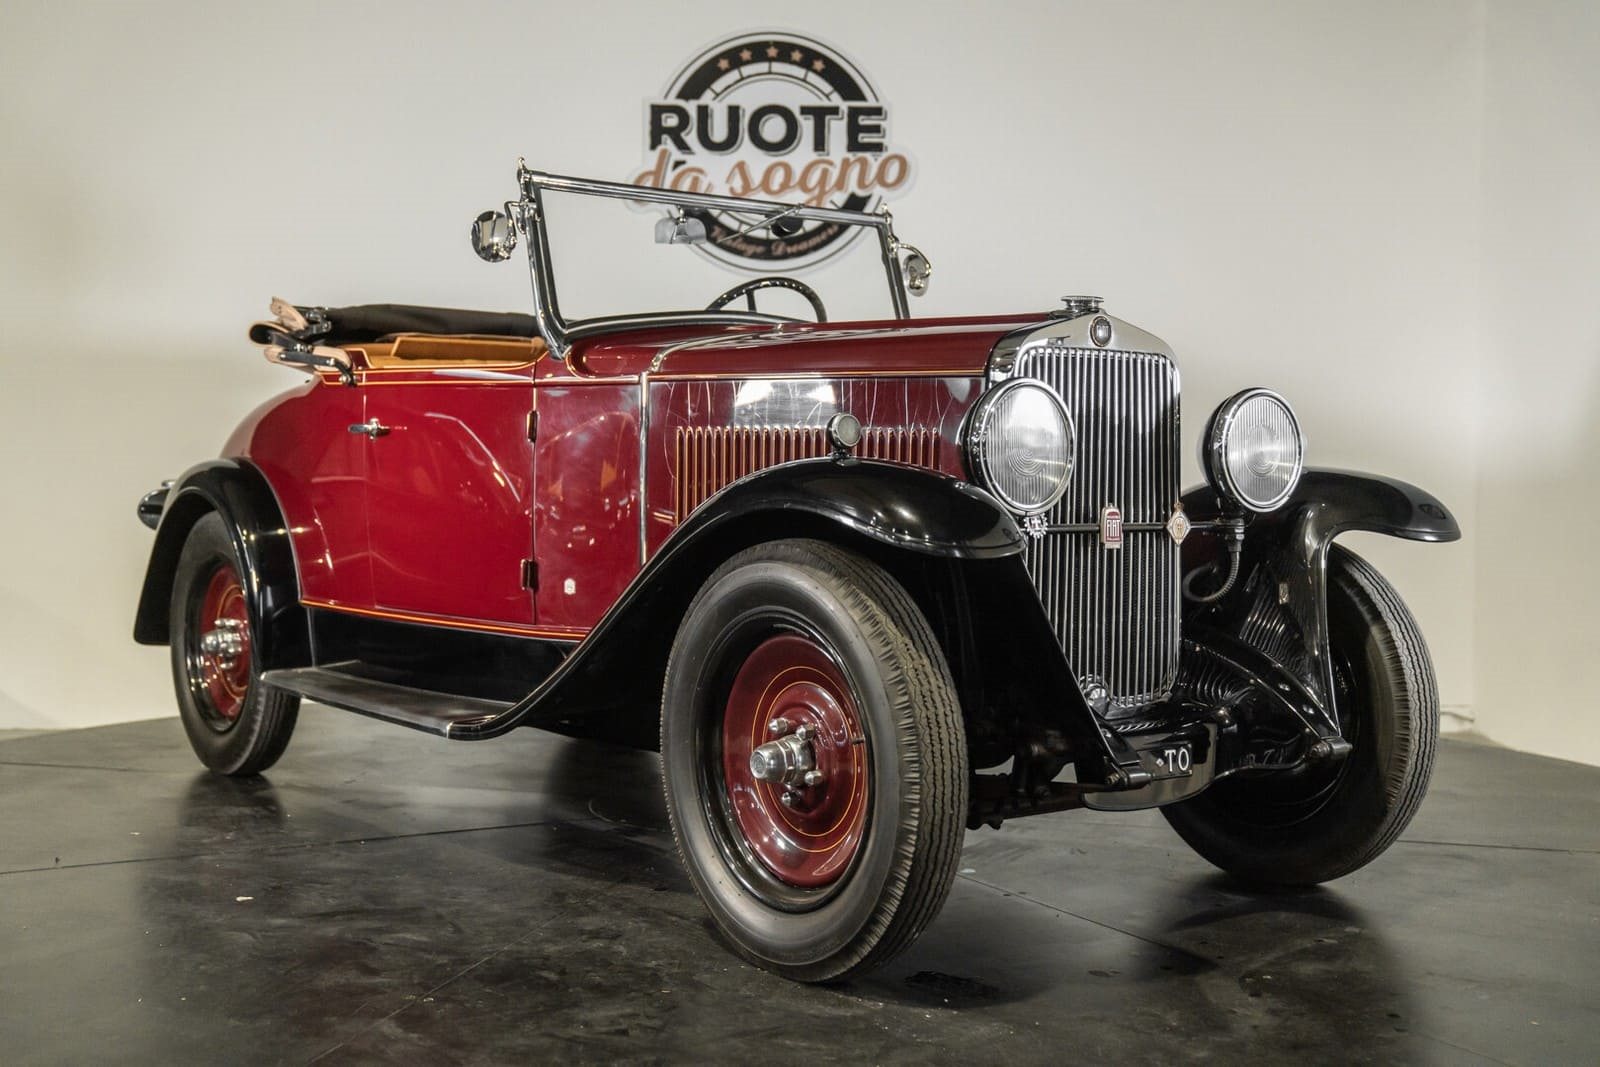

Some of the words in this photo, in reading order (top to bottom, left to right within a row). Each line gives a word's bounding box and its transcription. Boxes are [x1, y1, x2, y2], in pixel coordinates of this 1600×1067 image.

[650, 104, 886, 155] RUOTE
[725, 152, 908, 208] sogno
[1106, 519, 1121, 538] FIAT
[1164, 748, 1189, 772] TO
